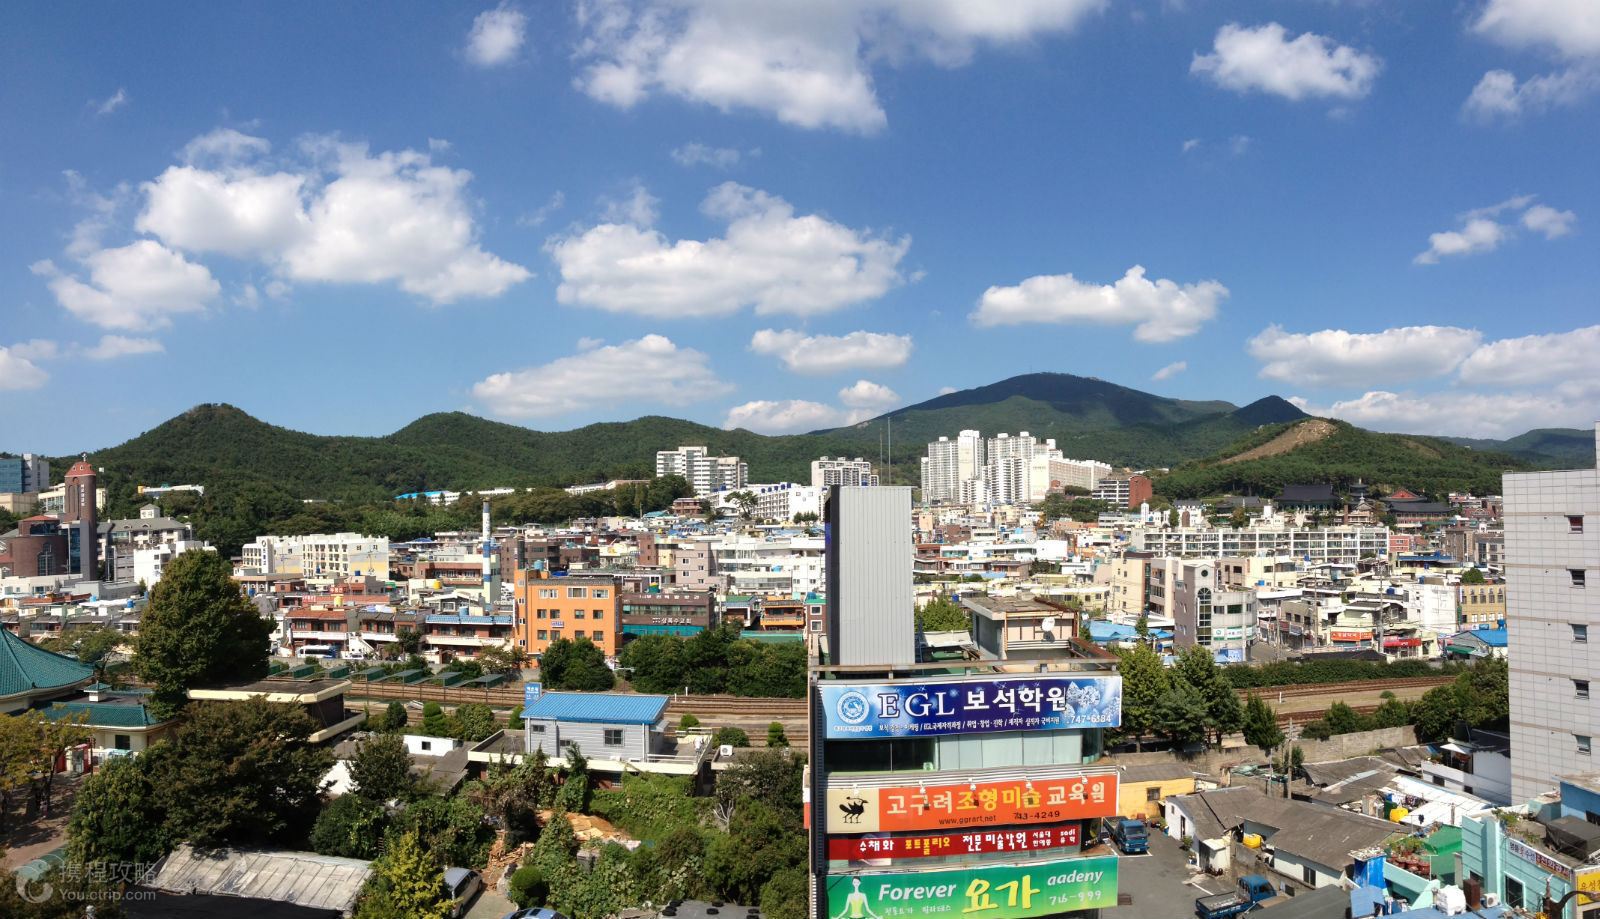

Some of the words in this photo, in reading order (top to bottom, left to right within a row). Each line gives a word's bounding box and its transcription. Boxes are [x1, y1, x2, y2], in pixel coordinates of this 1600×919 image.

[878, 691, 955, 718] EGL
[964, 687, 1067, 713] 보석학원
[886, 791, 953, 816] 고구려
[1047, 782, 1105, 805] 교육원
[939, 814, 997, 826] www.ggrart.net
[859, 839, 894, 853] 수채화
[905, 837, 950, 856] 포트폴리오
[962, 834, 982, 852] 전문
[1032, 830, 1051, 839] 서울대
[878, 882, 957, 902] Forever
[961, 874, 1041, 914] 요가
